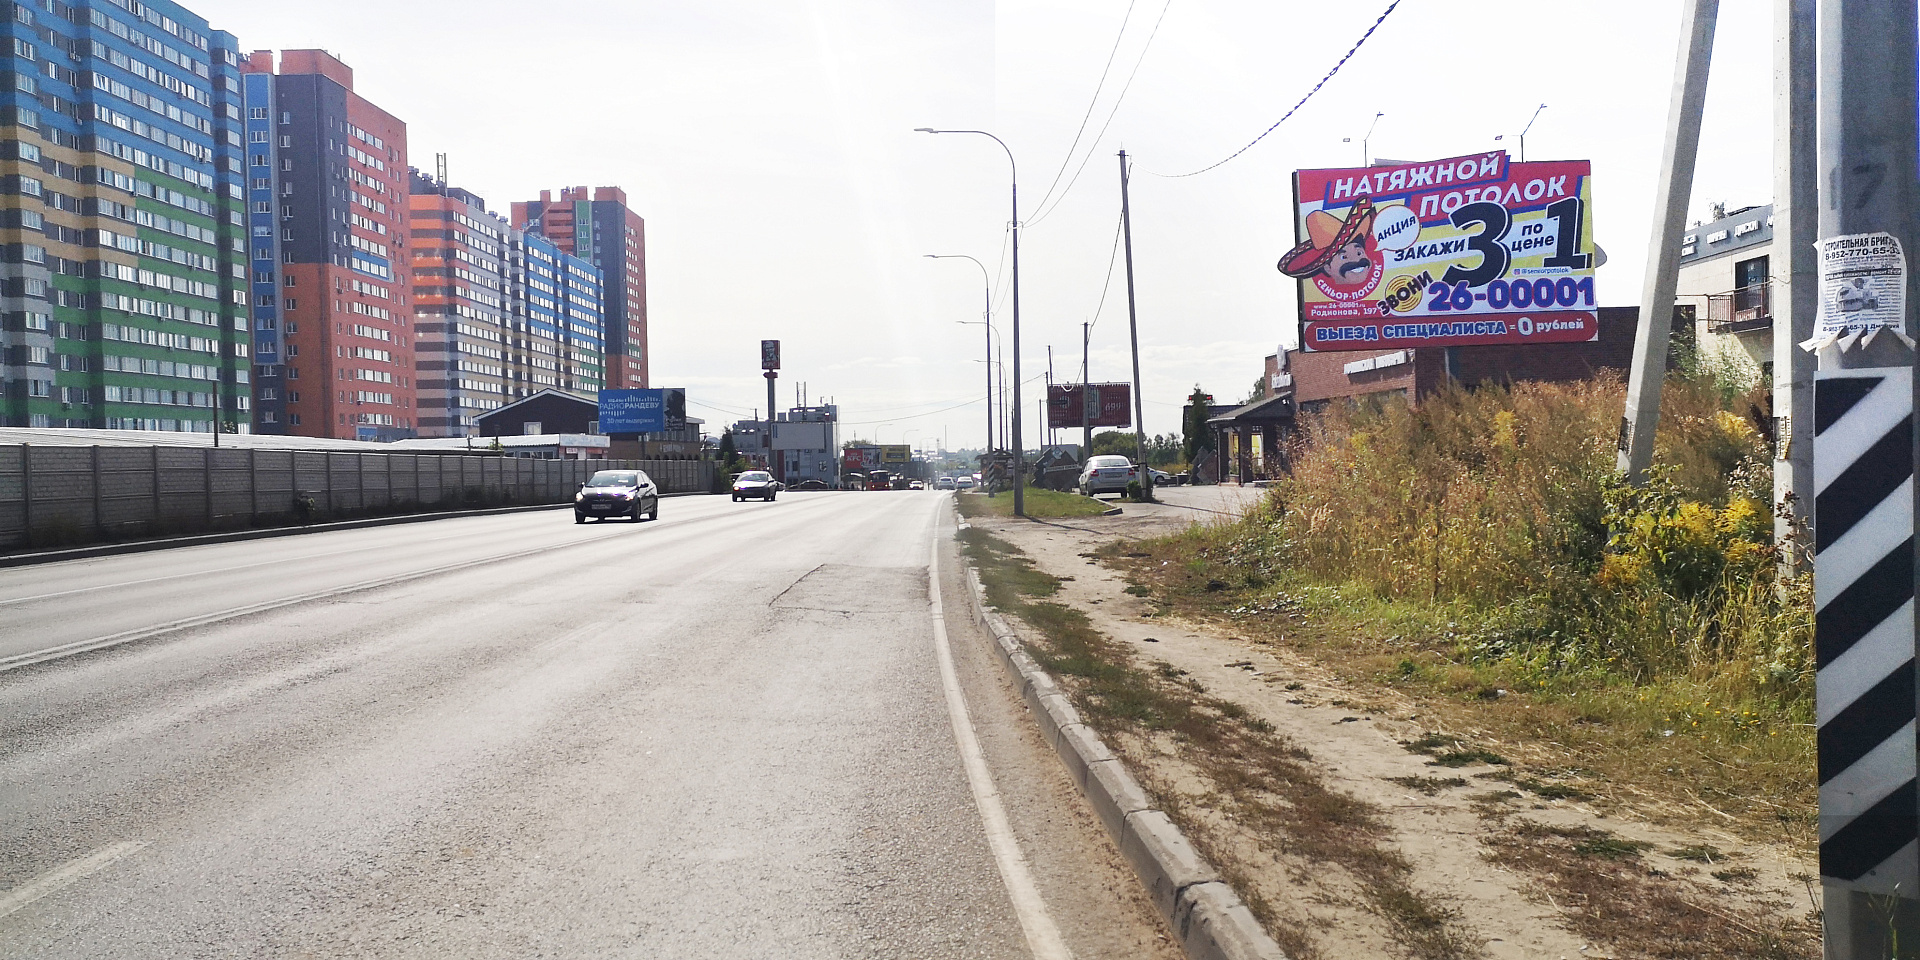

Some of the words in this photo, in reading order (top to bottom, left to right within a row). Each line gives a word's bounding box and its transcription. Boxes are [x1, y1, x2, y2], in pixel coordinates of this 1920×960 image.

[1333, 154, 1501, 200] НАТЯЖНОЙ
[1419, 174, 1567, 218] ПОТОЛОК
[1377, 215, 1417, 242] АКЦИЯ
[1393, 238, 1466, 262] ЗАКАЖИ
[1443, 201, 1512, 287] 3
[1511, 236, 1555, 253] цене
[1544, 197, 1590, 268] 1
[1521, 224, 1544, 236] по
[1825, 237, 1869, 252] СТРОИТЕЛЬНАЯ
[1377, 270, 1434, 316] ЗВОНИ
[1428, 277, 1596, 312] 26-00001
[1311, 308, 1361, 317] Родионова,
[1316, 324, 1378, 342] ВЫЕЗД
[1383, 319, 1507, 339] СПЕЦИАЛИСТА
[1536, 317, 1584, 334] рублей
